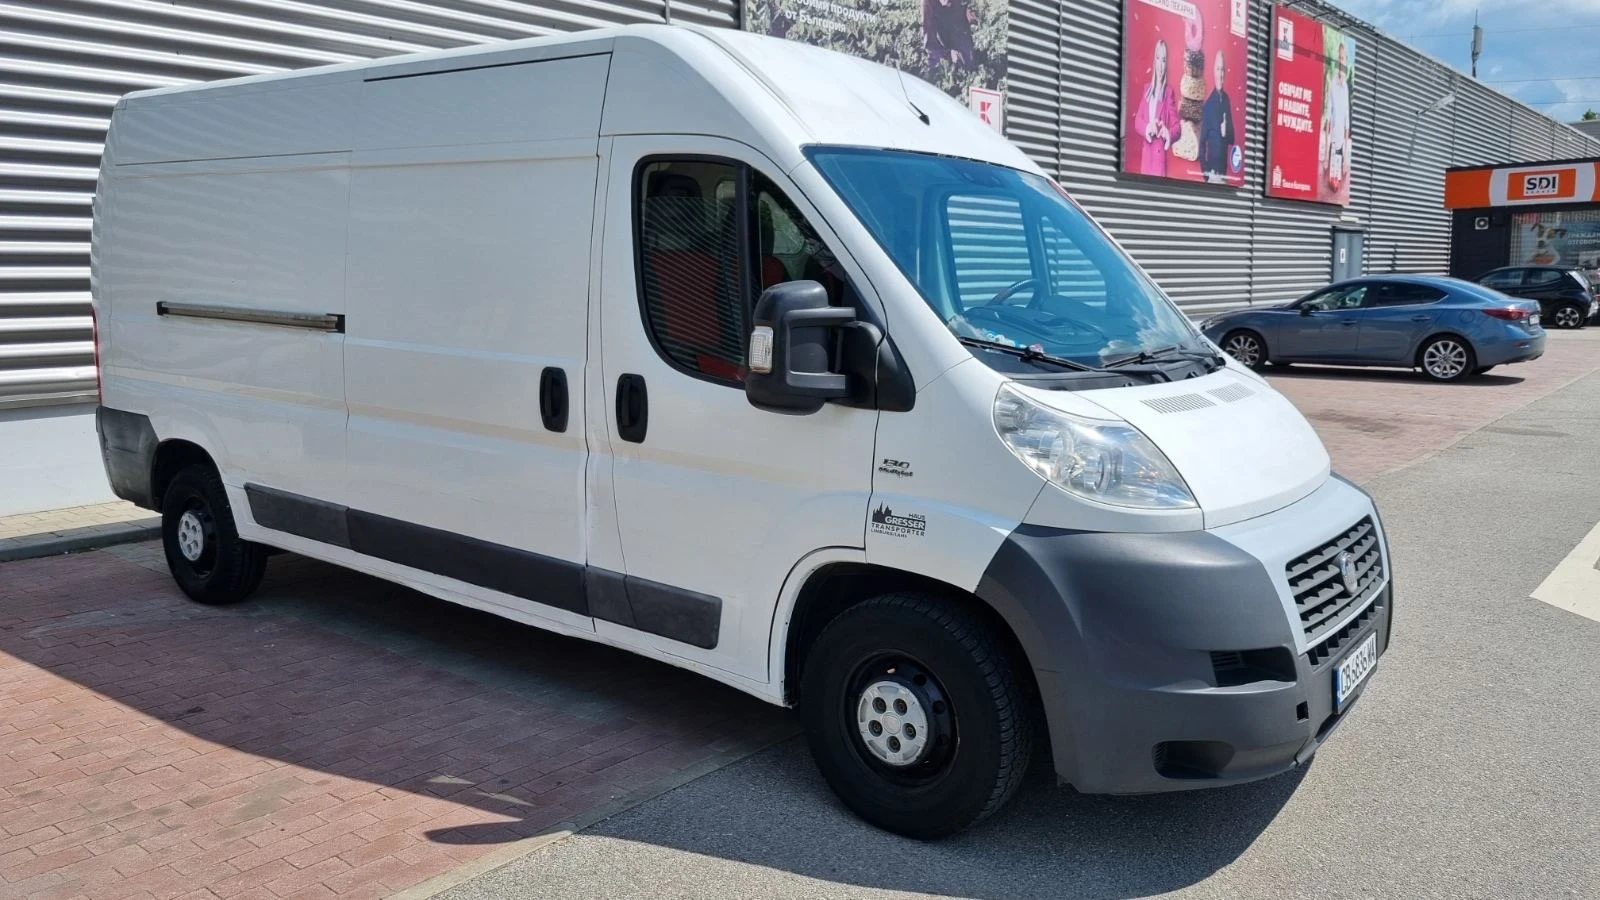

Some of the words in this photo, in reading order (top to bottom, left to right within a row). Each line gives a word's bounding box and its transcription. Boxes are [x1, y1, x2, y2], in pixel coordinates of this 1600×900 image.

[785, 10, 797, 20] от
[800, 10, 846, 32] България
[1279, 81, 1303, 100] ОБИЧАТ
[1526, 176, 1556, 190] SDI
[883, 459, 910, 469] 130
[884, 516, 926, 530] GRESSER
[908, 513, 926, 521] HAUS
[871, 522, 926, 537] TRANSPORTER
